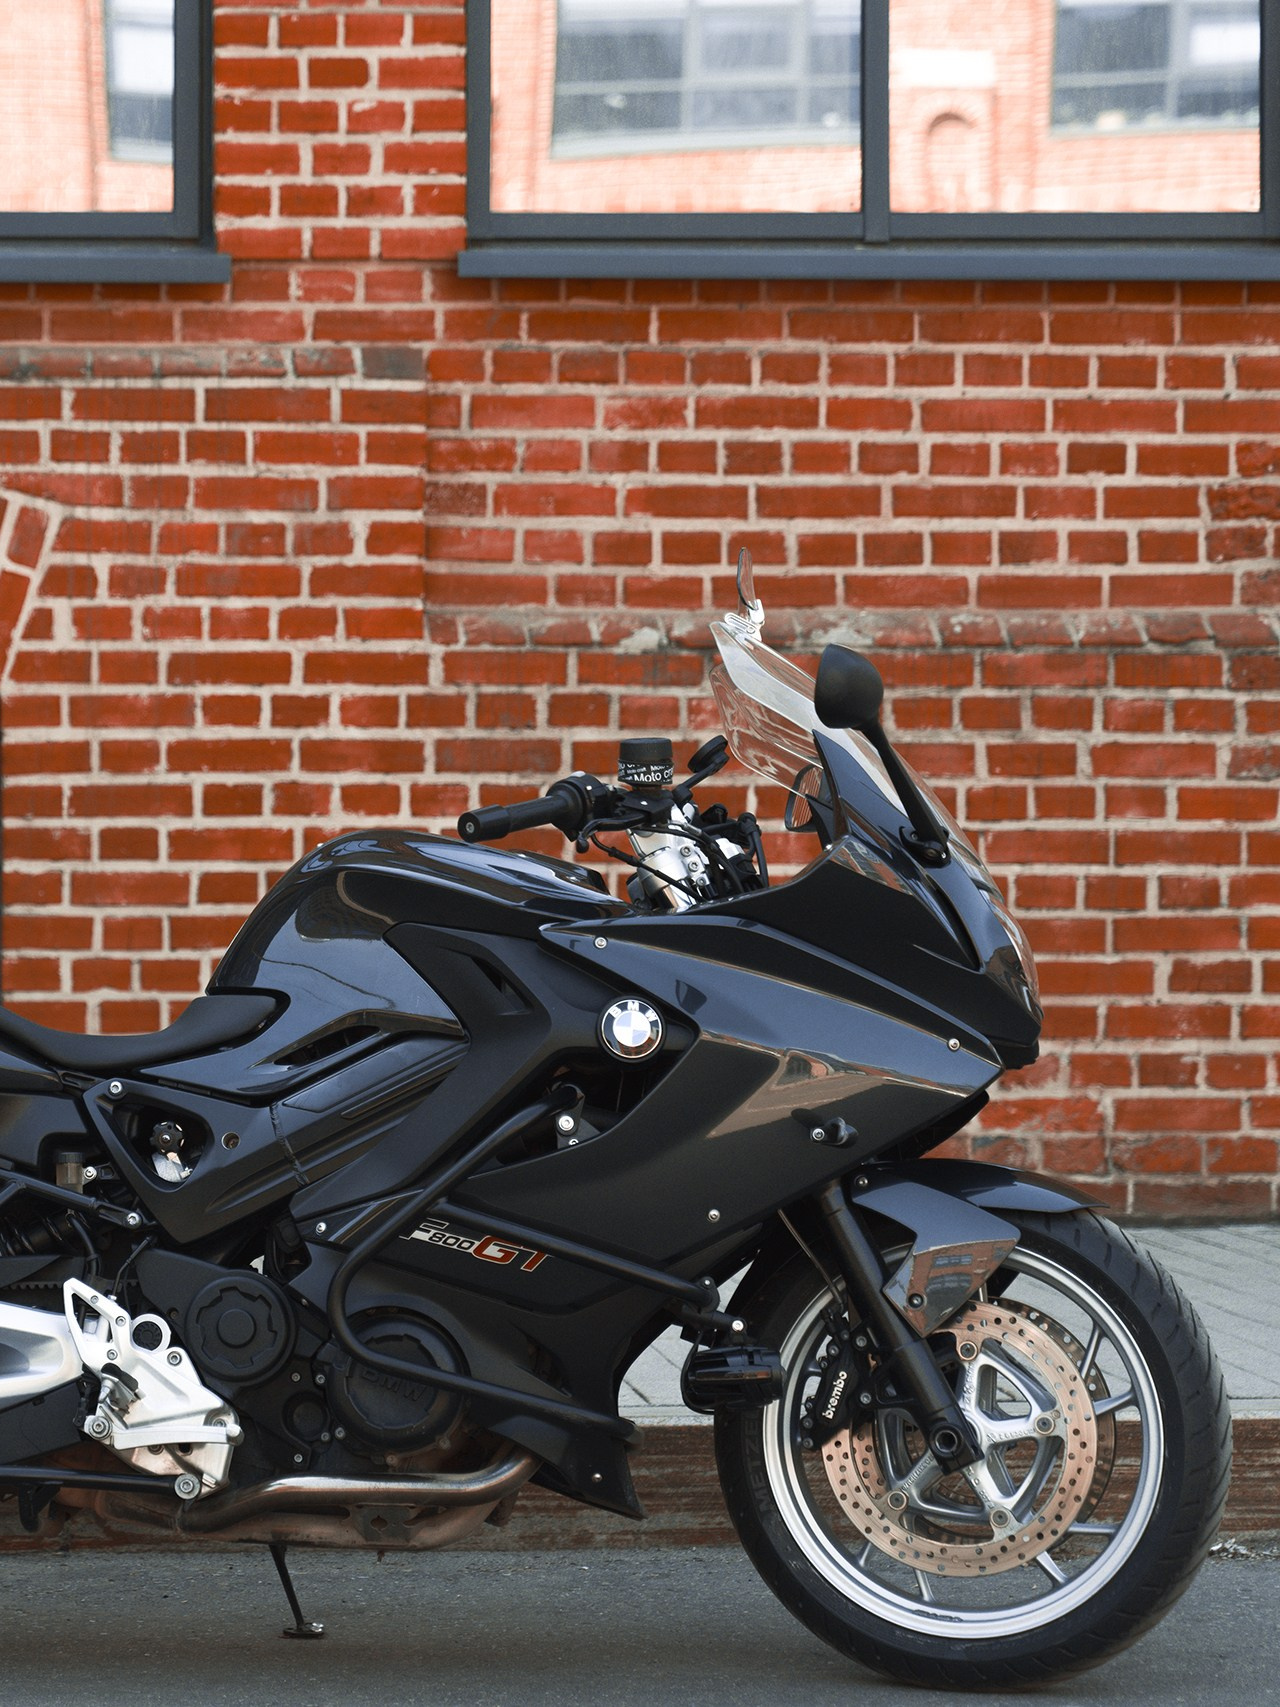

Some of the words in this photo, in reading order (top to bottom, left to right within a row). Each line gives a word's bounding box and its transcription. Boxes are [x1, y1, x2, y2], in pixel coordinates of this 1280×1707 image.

[634, 772, 662, 782] Moto
[360, 1367, 427, 1402] BMW
[822, 1371, 847, 1419] brembo
[745, 1409, 771, 1513] METZEL
